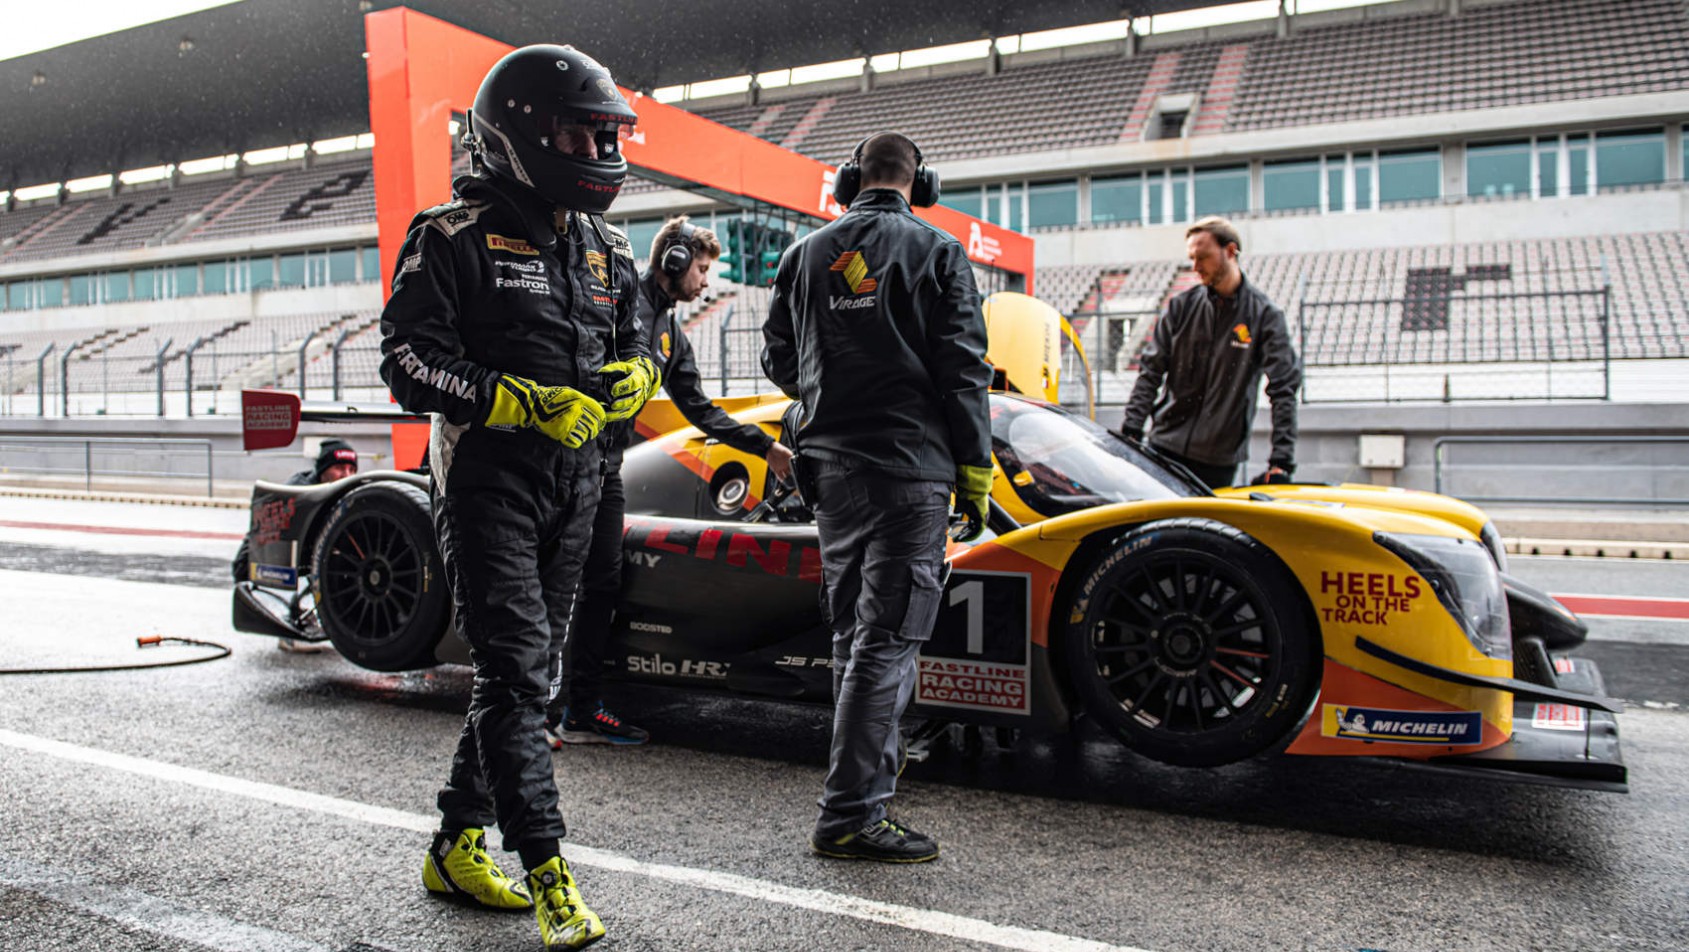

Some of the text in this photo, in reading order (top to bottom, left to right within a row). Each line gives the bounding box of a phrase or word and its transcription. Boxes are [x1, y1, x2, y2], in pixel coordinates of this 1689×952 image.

[495, 277, 550, 291] Fastron
[829, 296, 876, 310] VIRAGE
[246, 412, 291, 420] RACING
[1082, 535, 1153, 596] MICHELIN
[1320, 571, 1421, 598] HEELS
[1335, 594, 1411, 612] ON THE
[949, 580, 984, 654] 1
[1320, 608, 1388, 626] TRACK
[629, 621, 673, 634] BOOSTED
[627, 653, 676, 675] Stilo
[774, 655, 807, 667] JS
[919, 660, 1027, 679] FASTLINE
[921, 673, 1023, 696] RACING
[921, 687, 1023, 707] ACADEMY
[1371, 719, 1469, 736] MICHELIN
